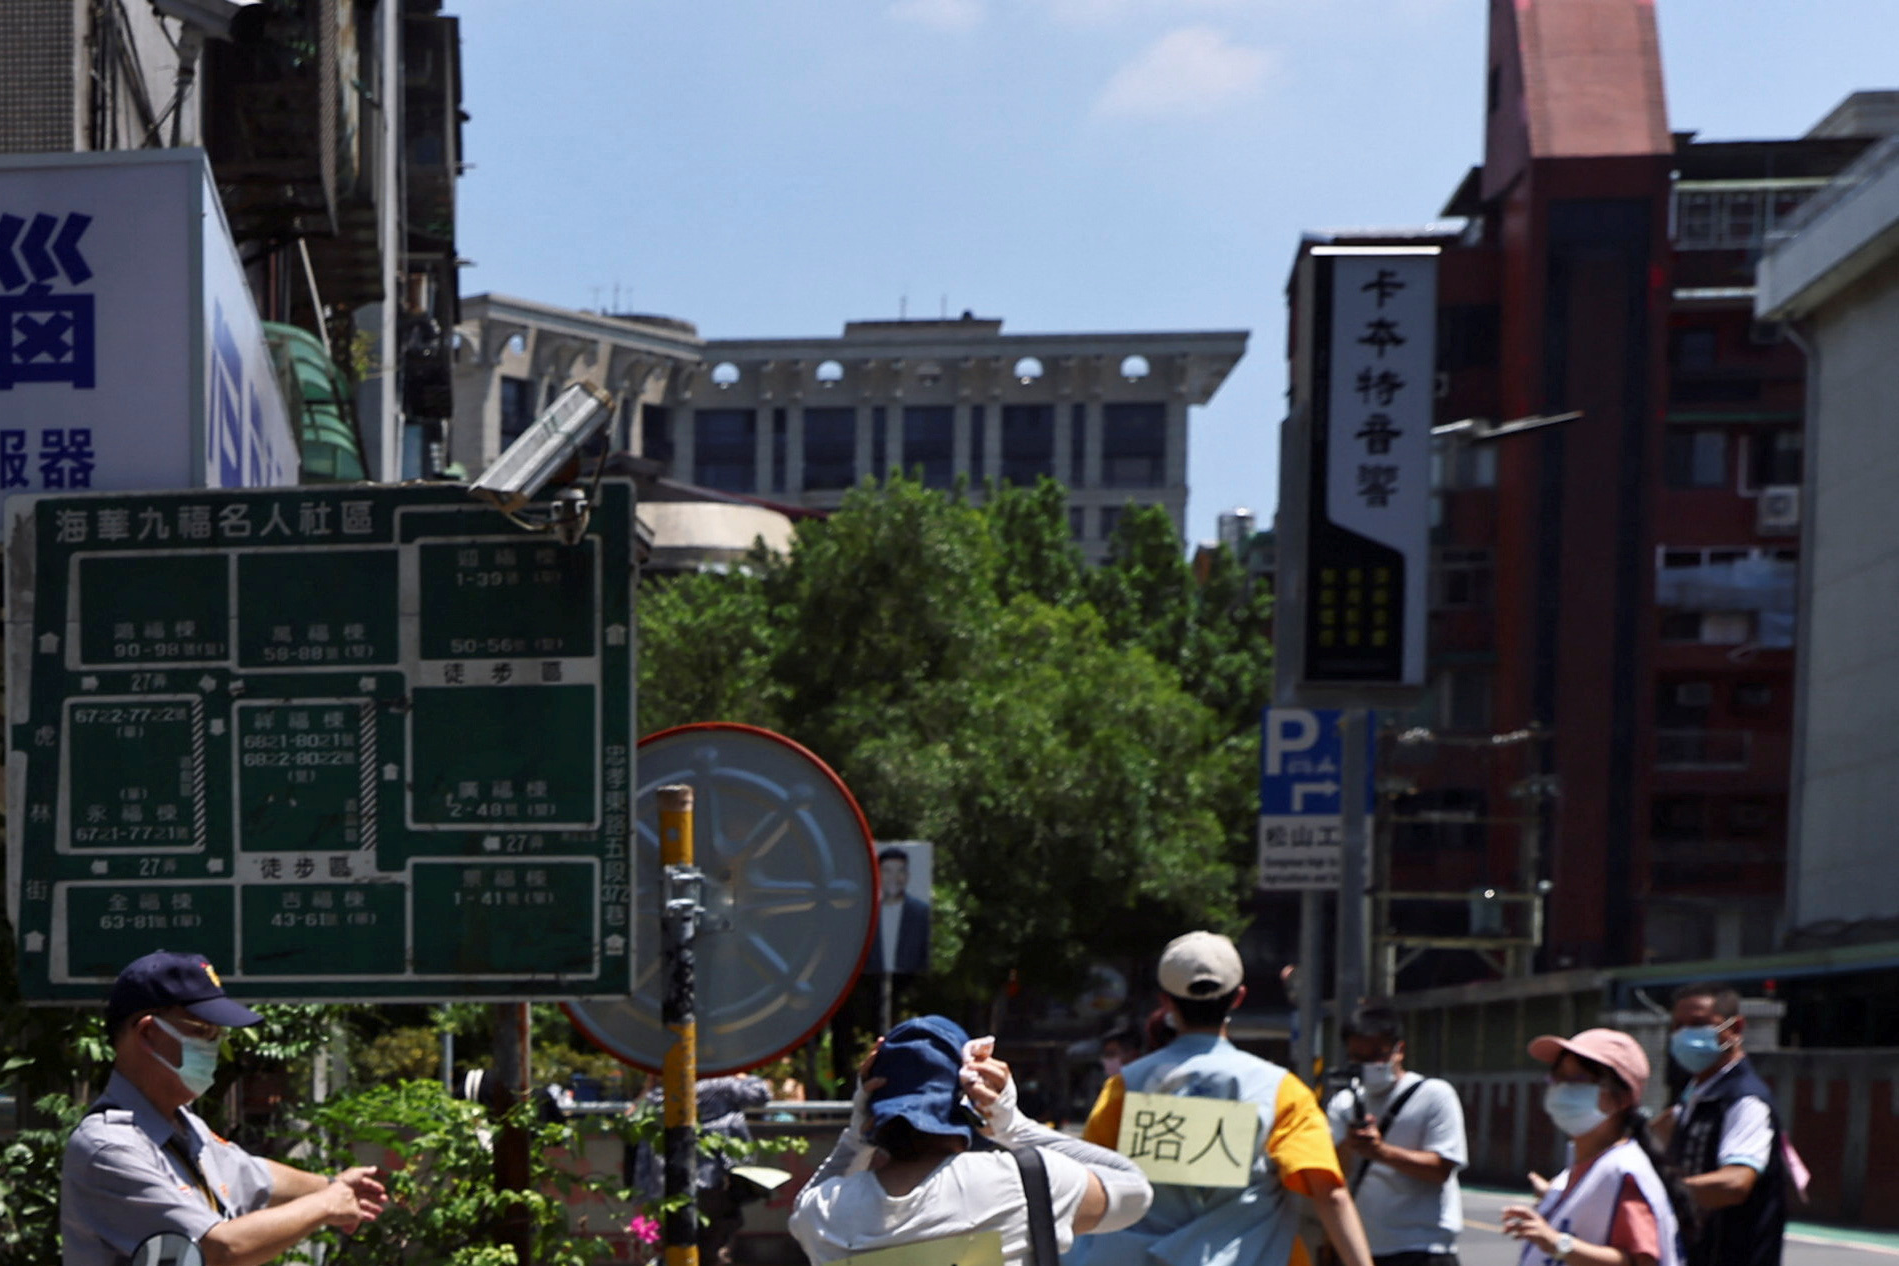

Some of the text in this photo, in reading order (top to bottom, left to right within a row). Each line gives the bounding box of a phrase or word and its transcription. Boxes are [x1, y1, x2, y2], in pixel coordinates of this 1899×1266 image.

[55, 499, 375, 543] 海華九福名人社區
[1265, 708, 1320, 776] P
[1129, 1110, 1241, 1168] 路人
